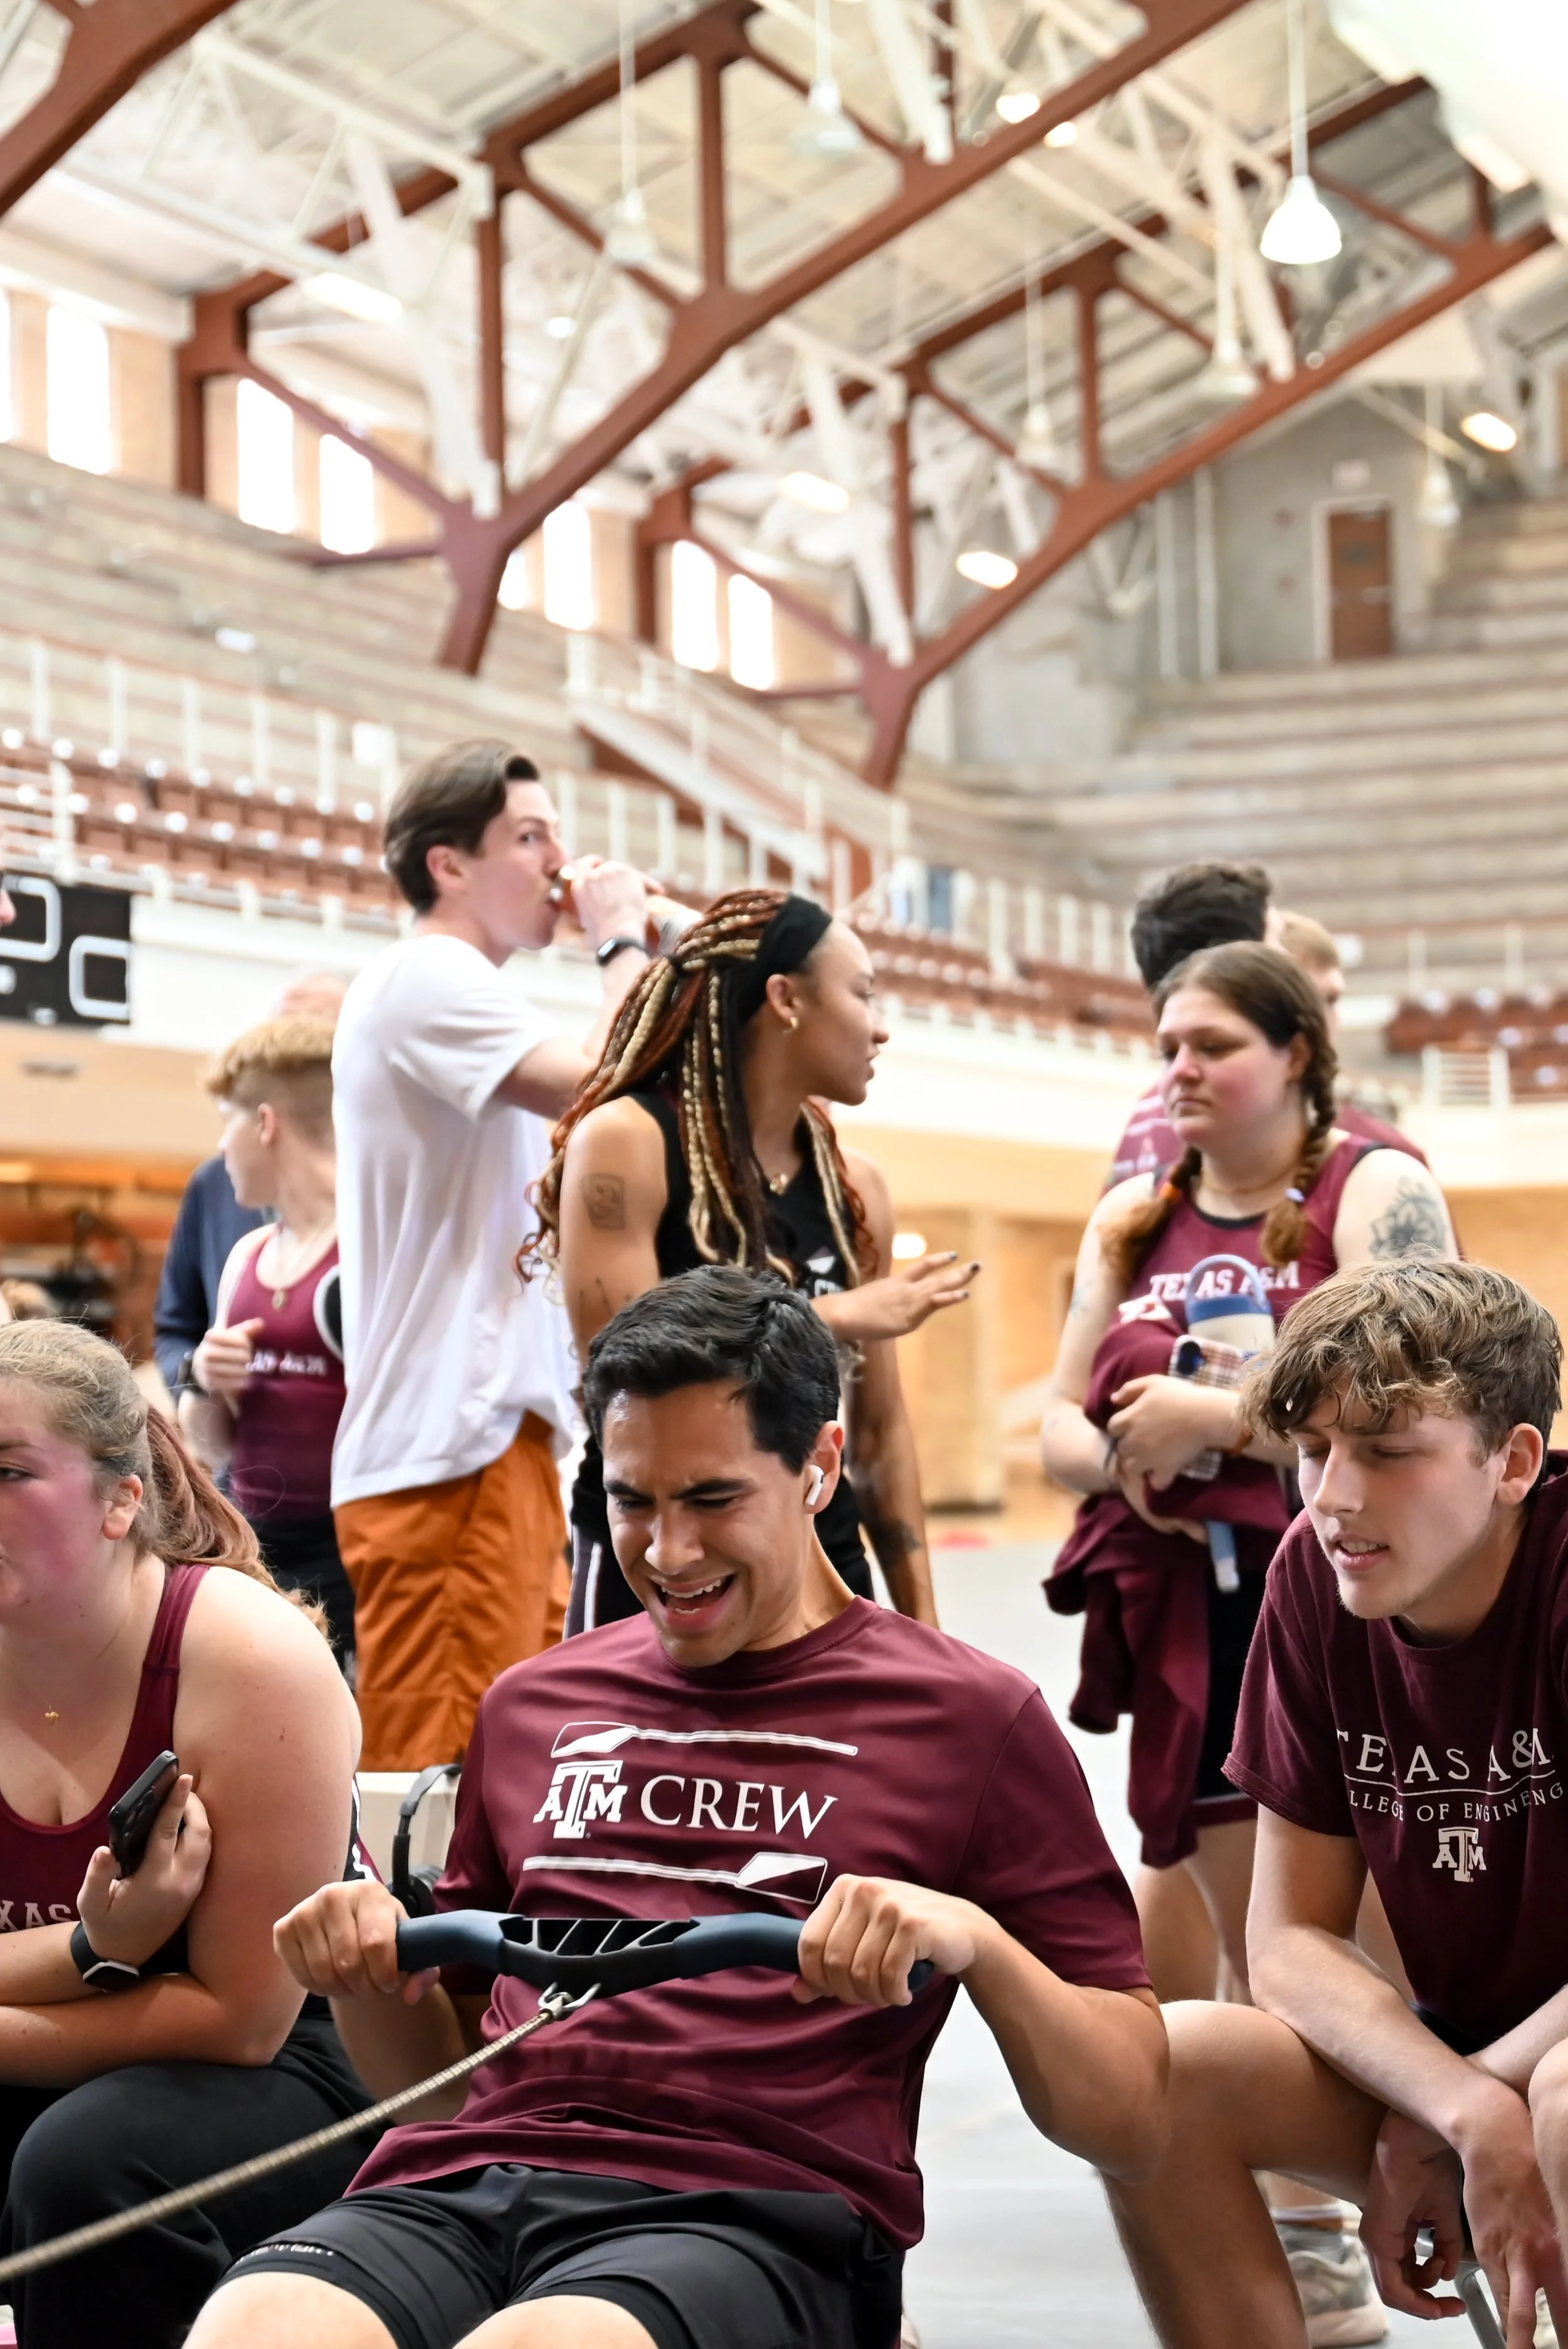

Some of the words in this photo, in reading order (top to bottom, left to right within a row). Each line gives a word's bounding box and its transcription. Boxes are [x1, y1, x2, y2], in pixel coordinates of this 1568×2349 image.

[1150, 1269, 1234, 1302] TEAS
[640, 1774, 838, 1839] CREW
[1416, 1803, 1449, 1821] OF
